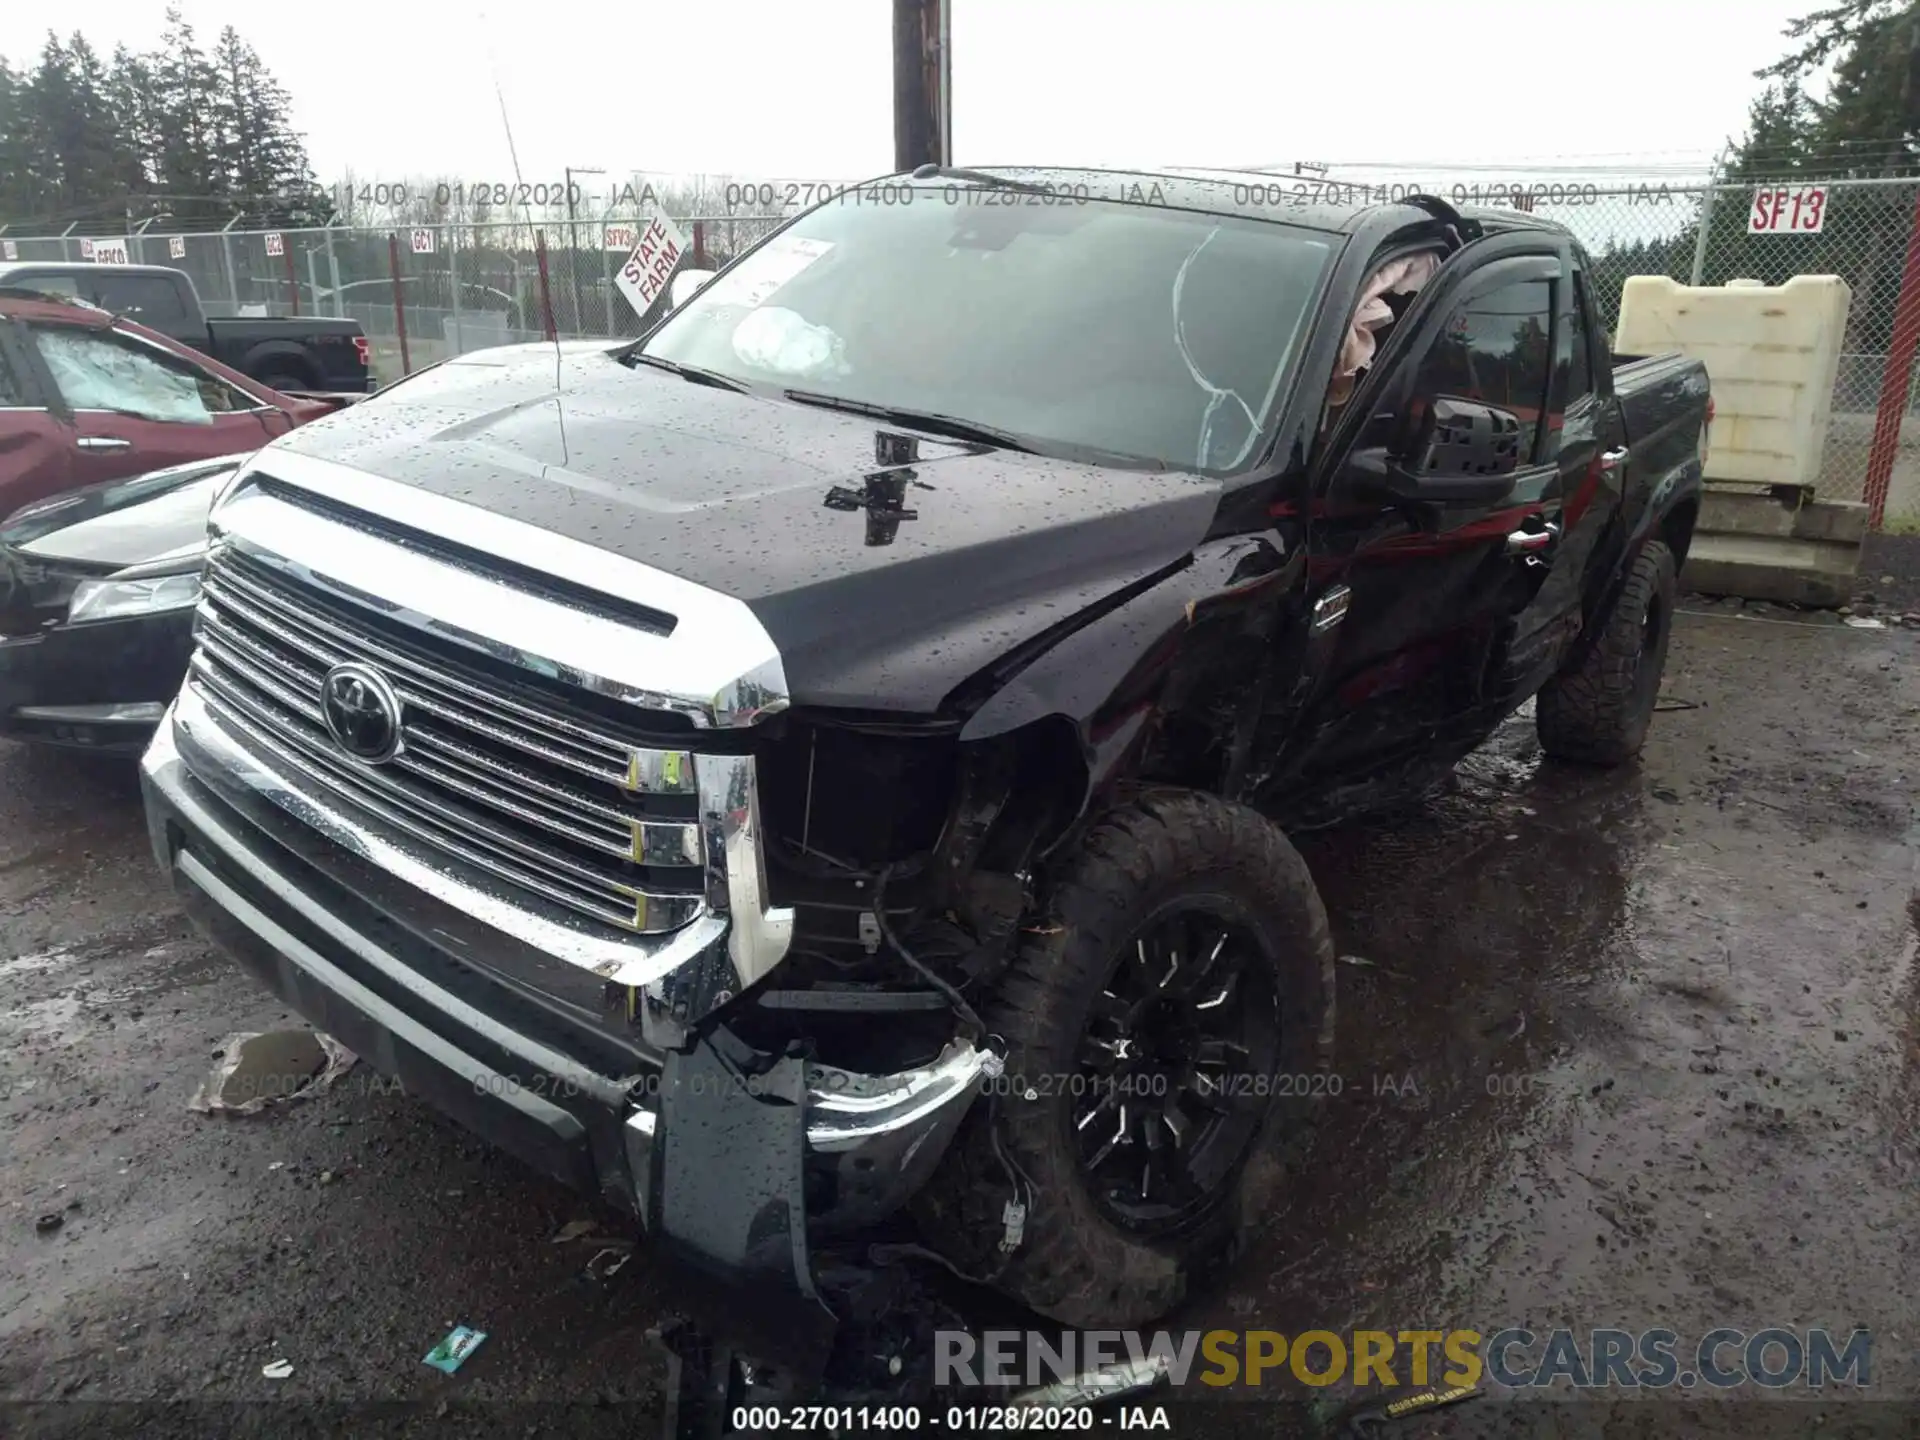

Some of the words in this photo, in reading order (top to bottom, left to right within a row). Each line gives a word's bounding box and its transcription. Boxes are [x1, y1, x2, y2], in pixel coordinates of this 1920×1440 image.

[1752, 191, 1825, 230] SF13
[624, 216, 667, 285] STATE
[639, 239, 679, 304] FARM
